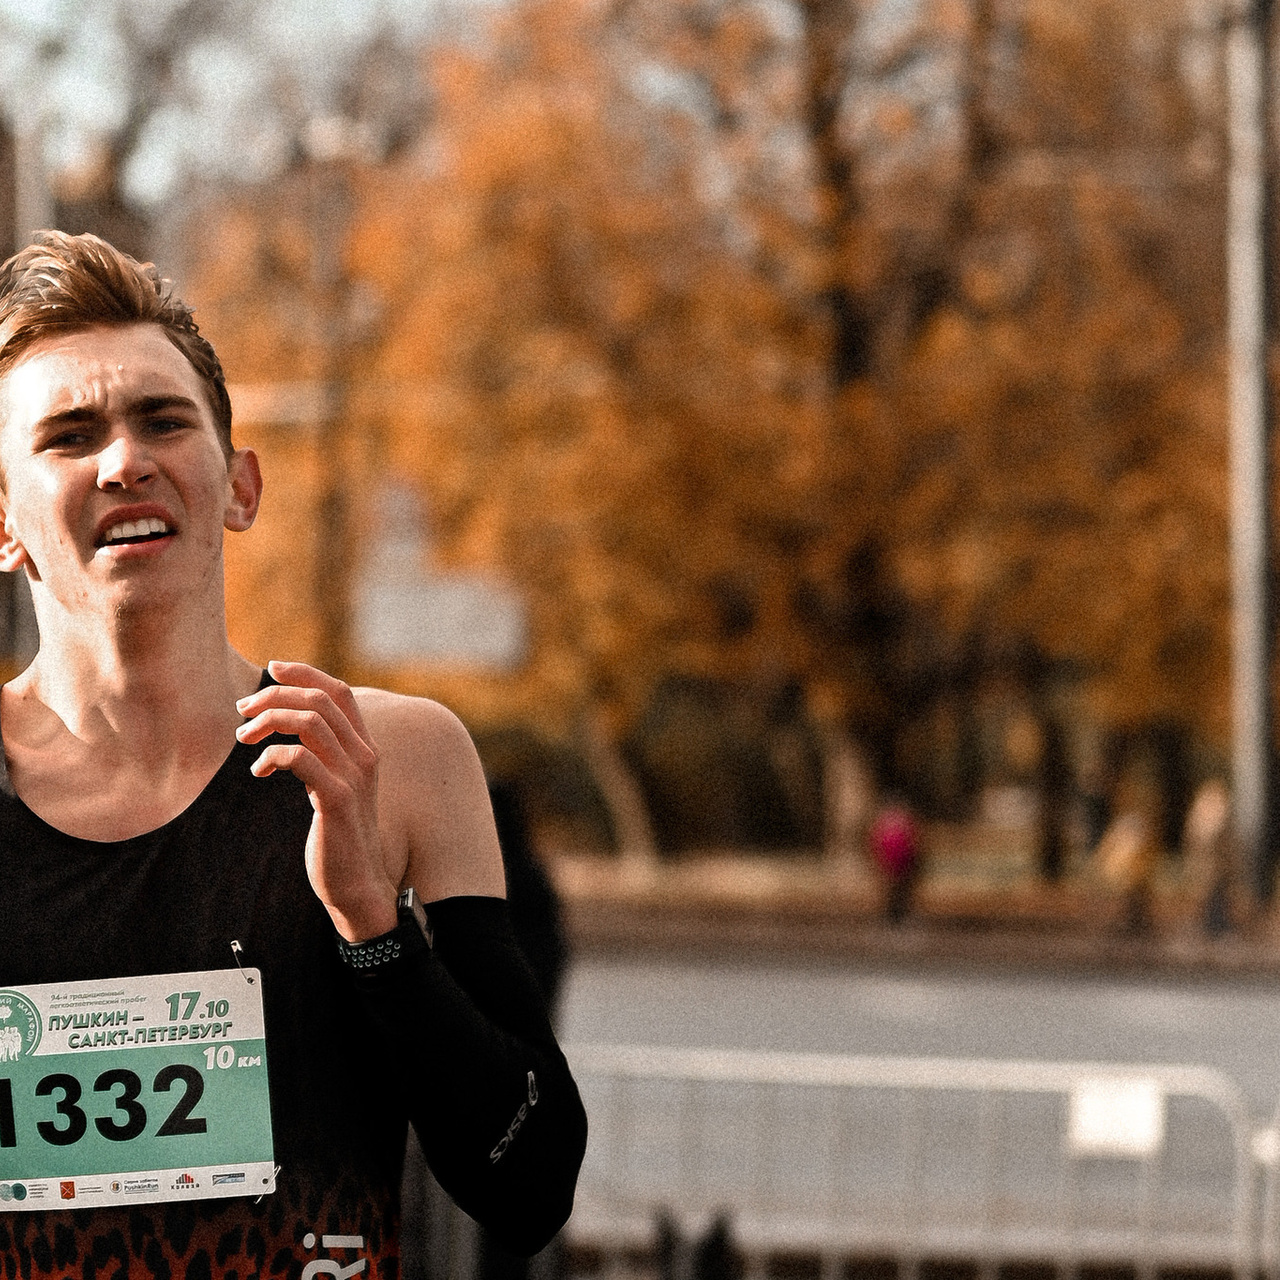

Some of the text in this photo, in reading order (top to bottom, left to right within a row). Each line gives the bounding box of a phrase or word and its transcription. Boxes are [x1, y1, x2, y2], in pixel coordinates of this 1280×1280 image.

[165, 991, 230, 1021] 17.10
[16, 1002, 35, 1042] МАРАФОН
[48, 1010, 128, 1031] ПУШКИН
[67, 1022, 233, 1049] САНКТ-ПЕТЕРБУРГ
[203, 1045, 235, 1070] 10
